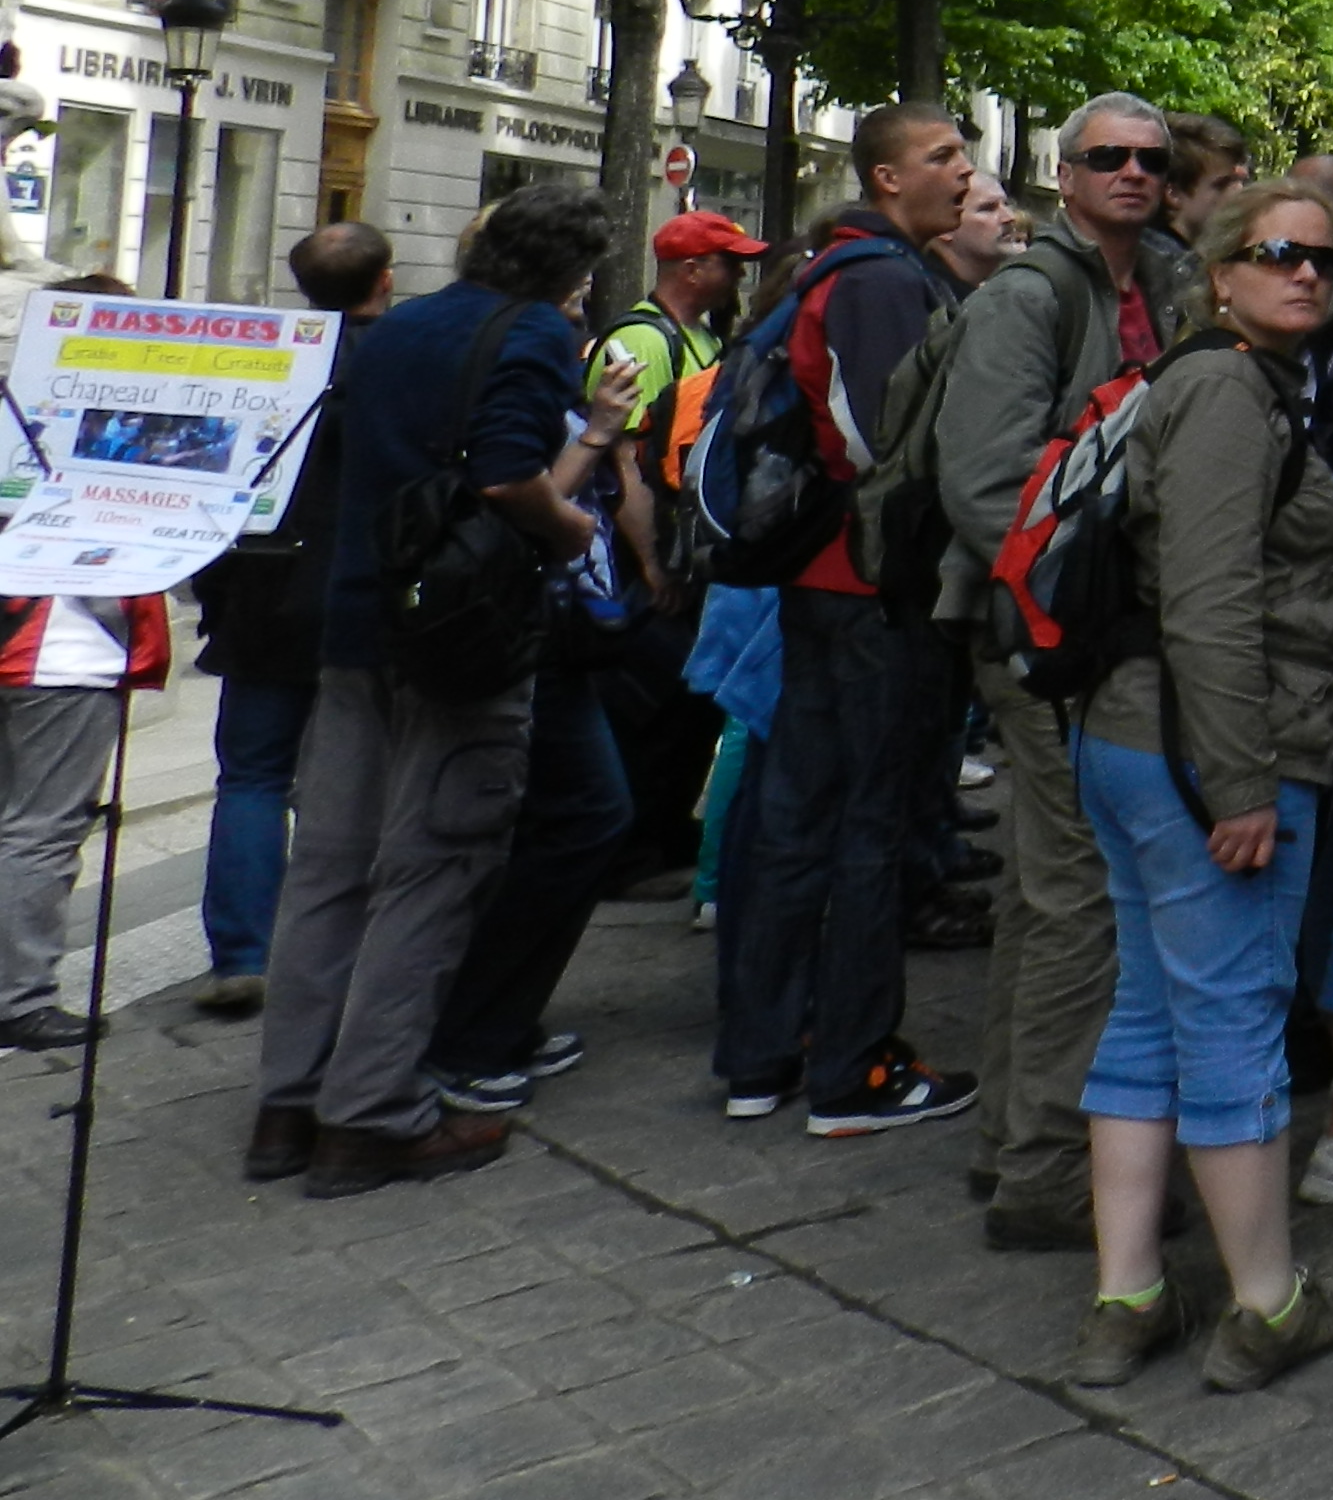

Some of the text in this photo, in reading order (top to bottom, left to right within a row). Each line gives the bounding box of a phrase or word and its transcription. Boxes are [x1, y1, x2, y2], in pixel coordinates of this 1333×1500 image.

[215, 72, 235, 98] J.
[241, 75, 294, 107] VRIN
[496, 115, 603, 153] PHILOSOPHIQU
[87, 308, 282, 343] MASSAGES
[143, 344, 187, 366] Free
[81, 484, 193, 510] MASSAGES
[26, 512, 77, 528] FREE
